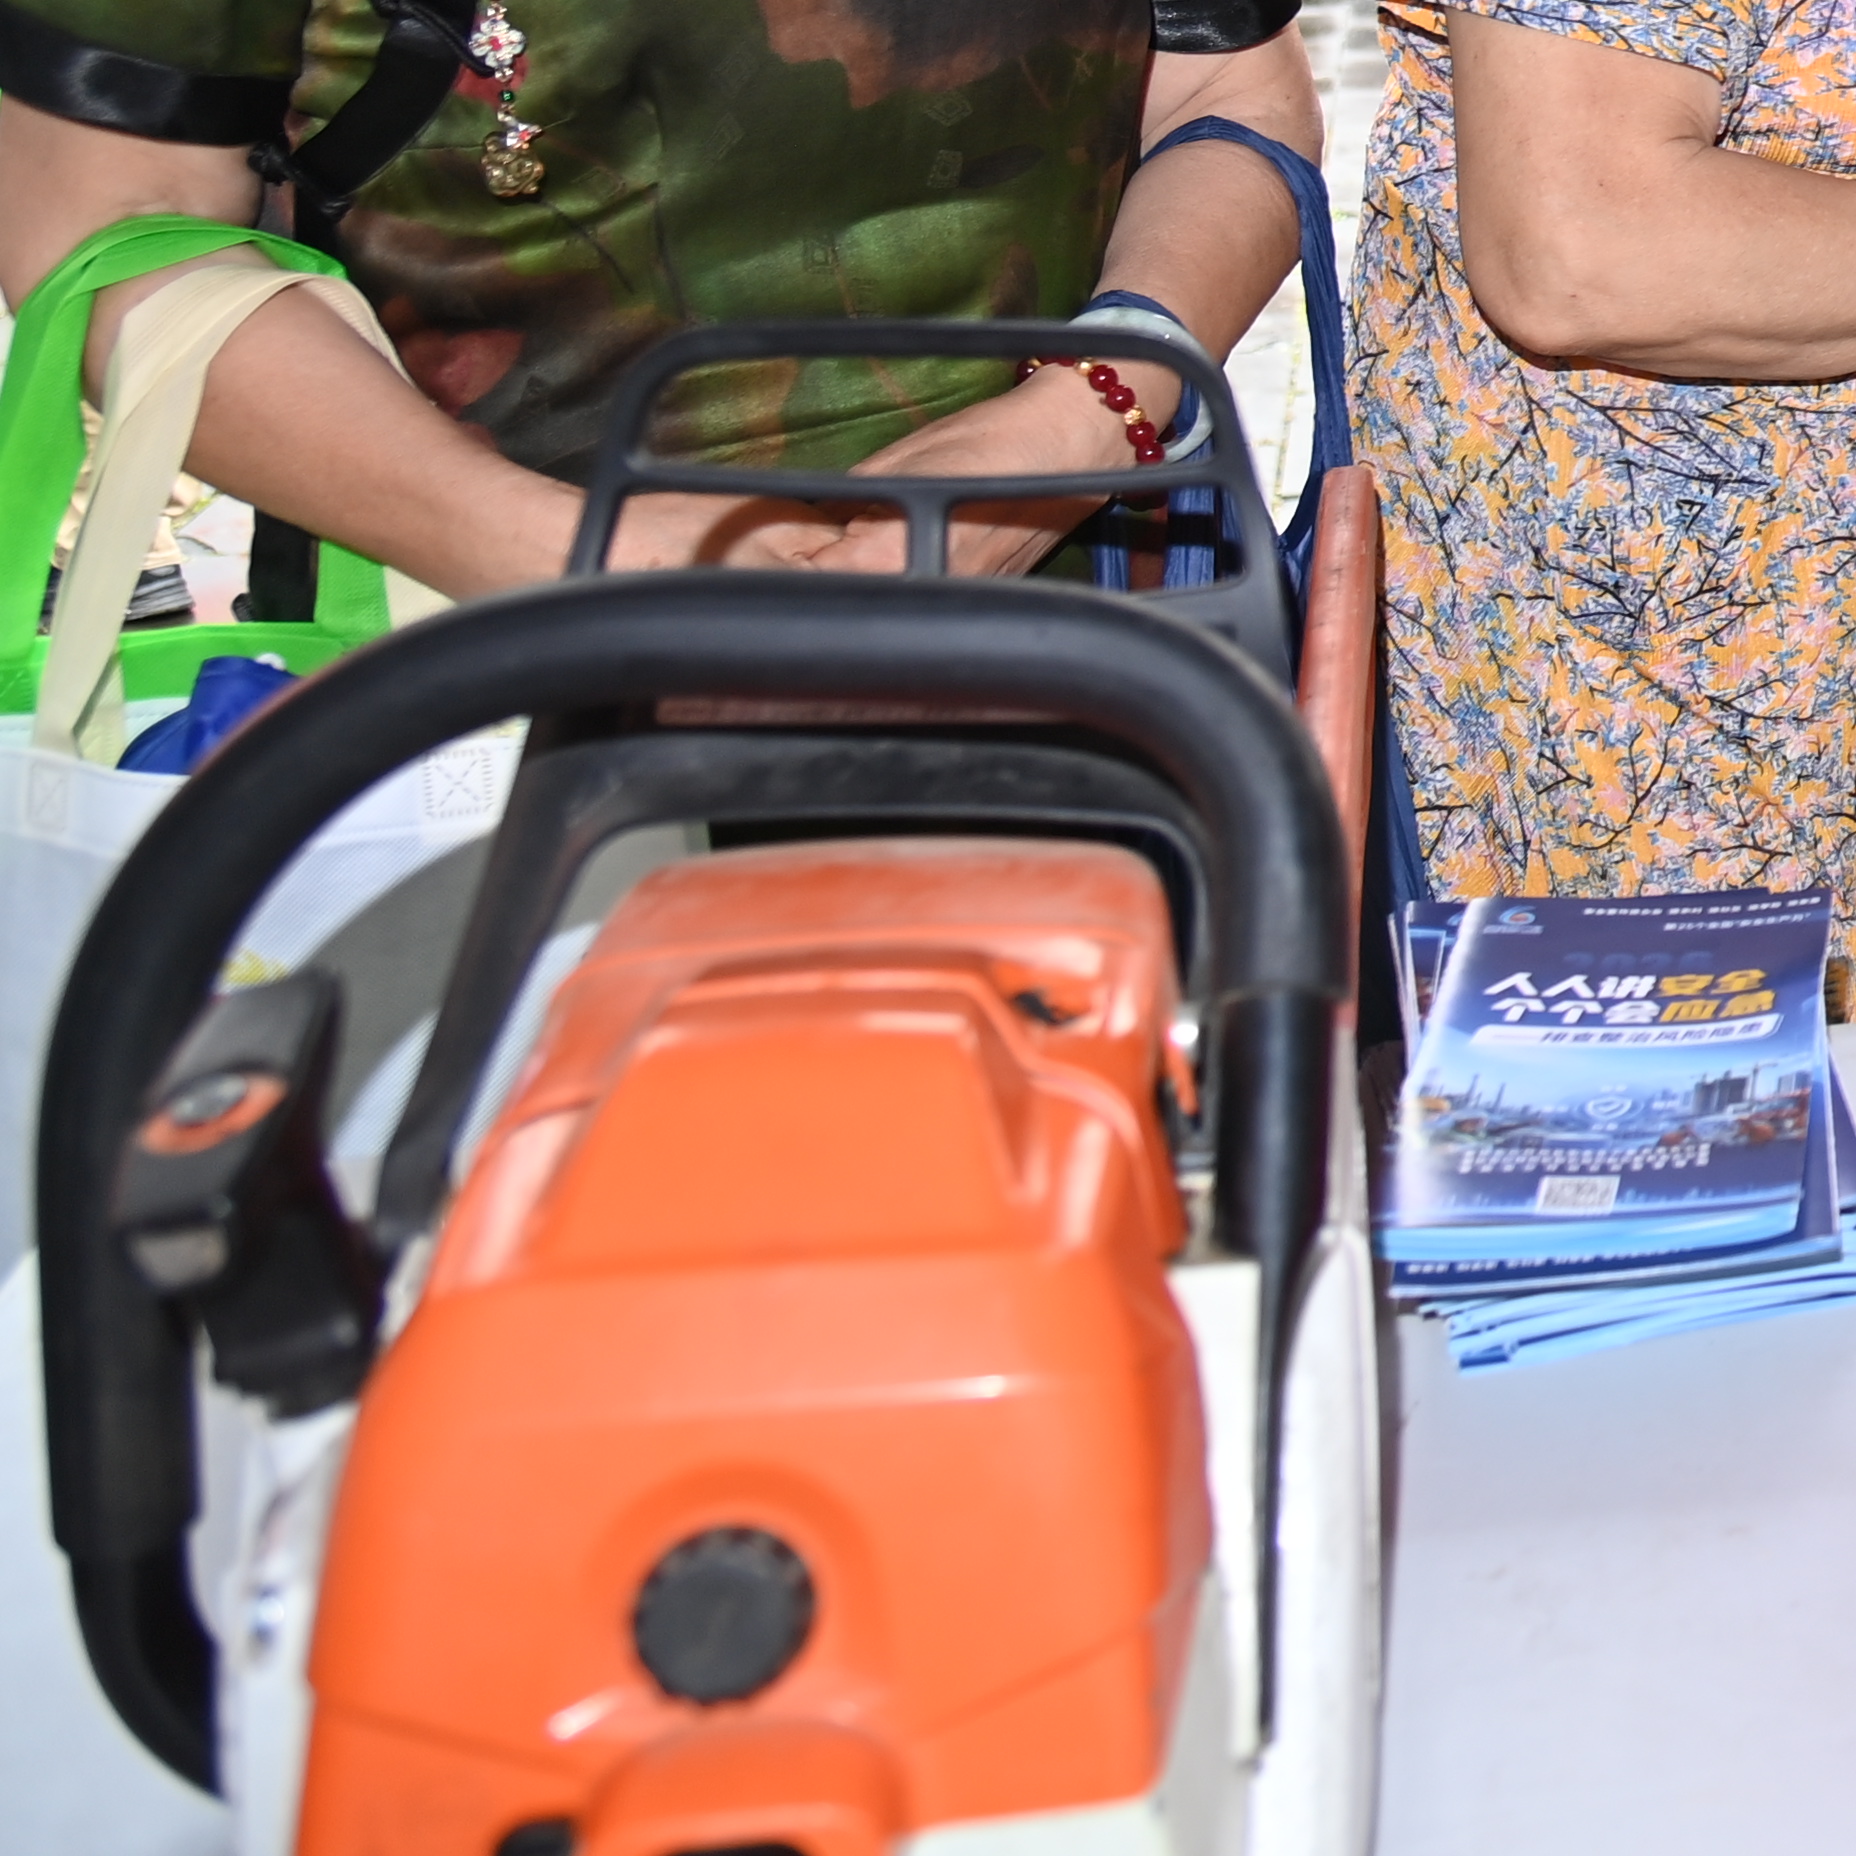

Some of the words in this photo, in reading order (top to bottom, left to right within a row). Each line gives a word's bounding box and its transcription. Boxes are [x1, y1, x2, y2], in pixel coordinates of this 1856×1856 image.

[1483, 967, 1768, 999] 人人讲安全
[1490, 990, 1777, 1025] 个个会应急
